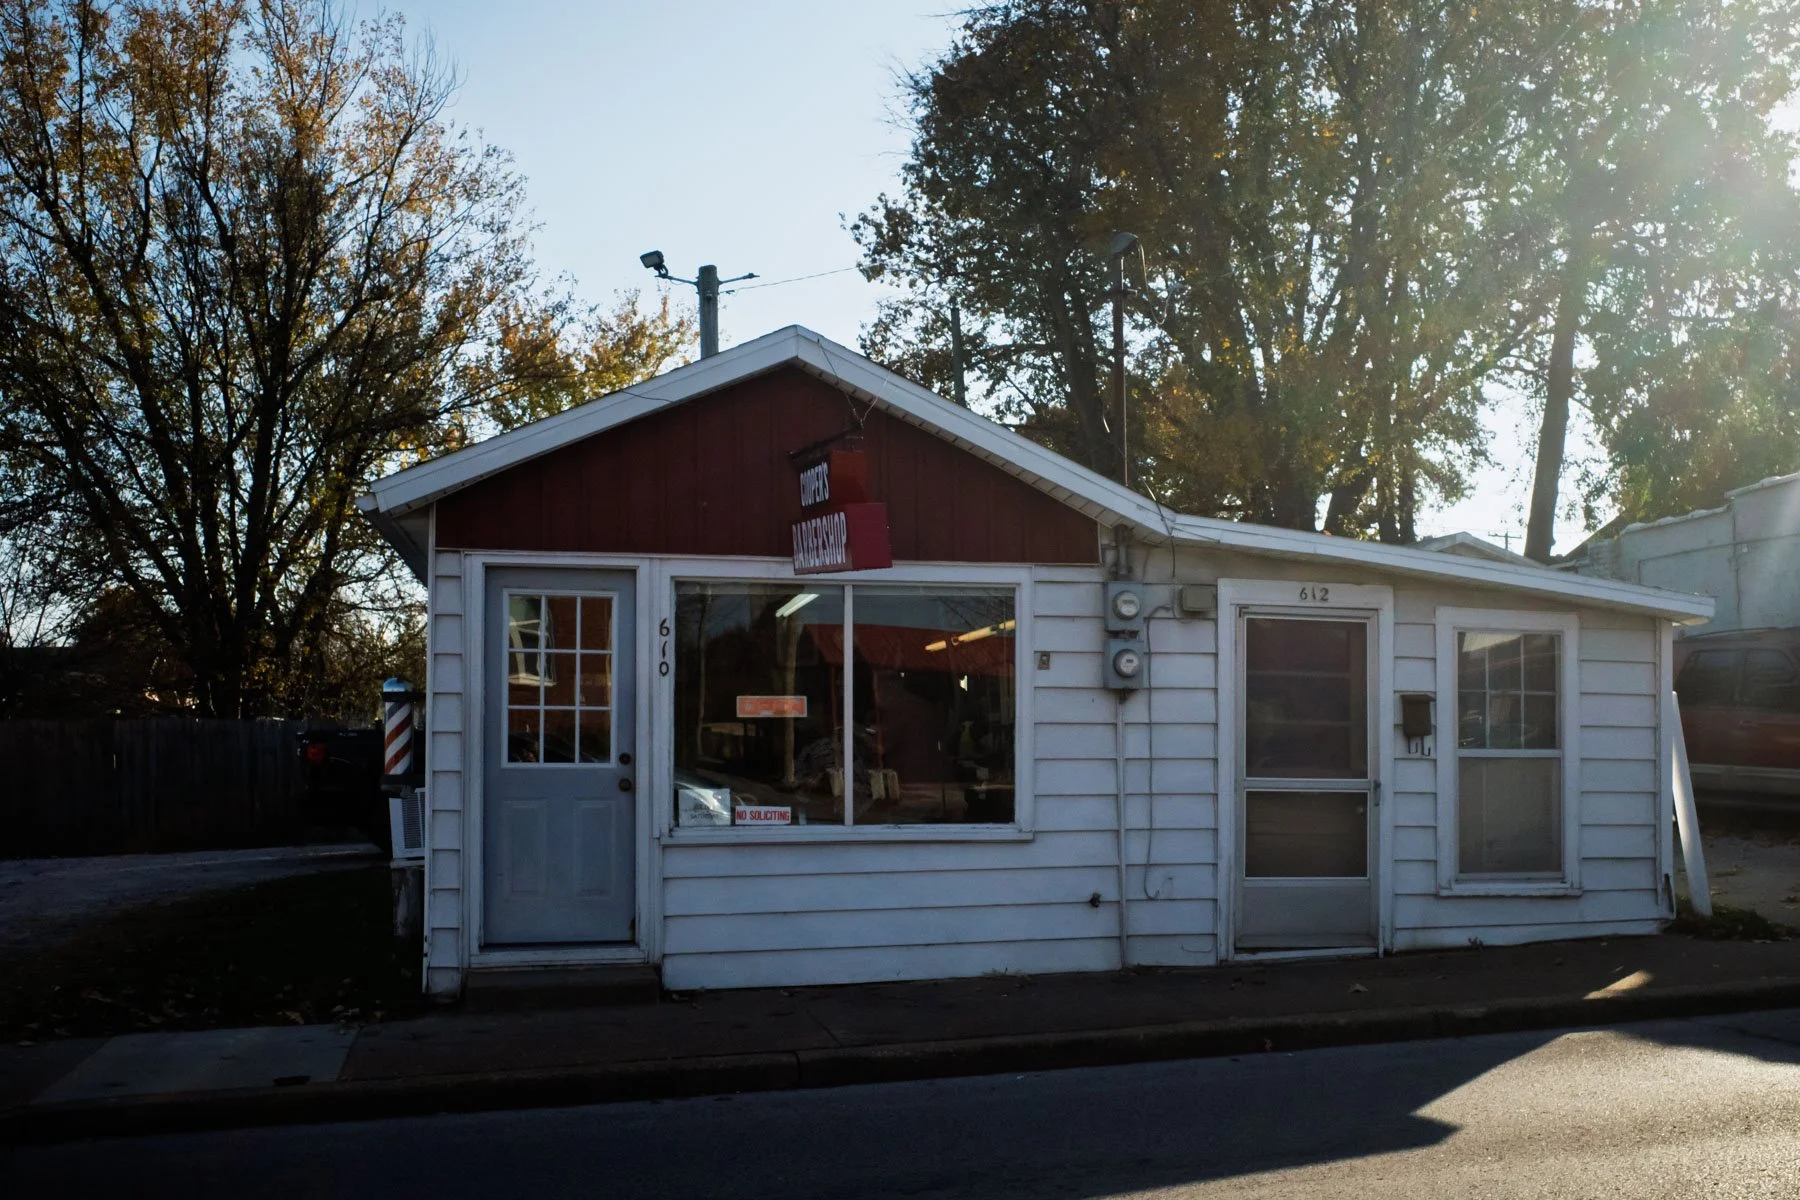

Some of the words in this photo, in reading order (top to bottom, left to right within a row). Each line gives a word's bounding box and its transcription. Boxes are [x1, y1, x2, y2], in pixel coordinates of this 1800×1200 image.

[800, 461, 829, 507] COOPER'S
[792, 512, 847, 569] BARBERSHOP
[1299, 587, 1329, 602] 612
[659, 617, 670, 677] 610
[736, 810, 747, 821] NO
[750, 810, 790, 821] SOLICITING
